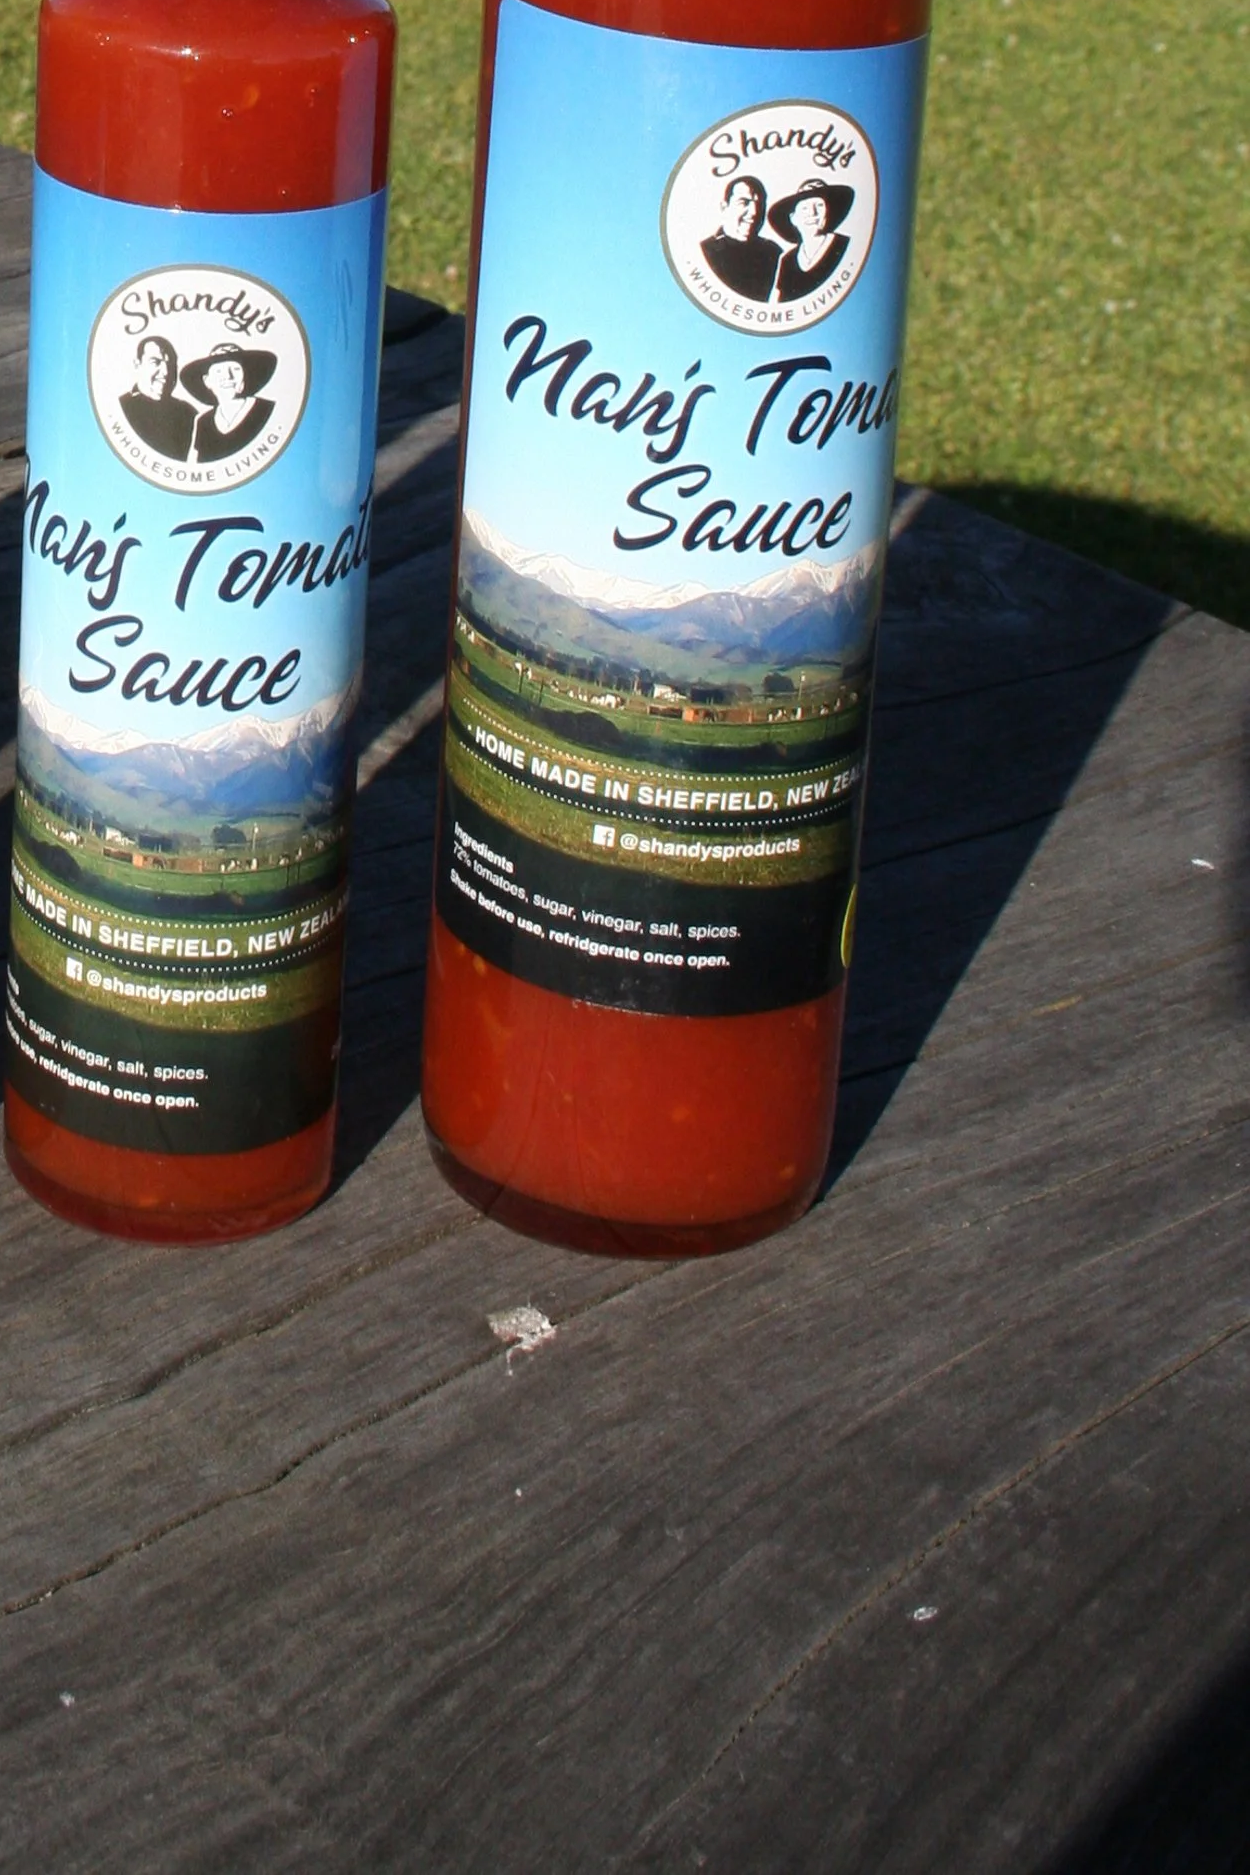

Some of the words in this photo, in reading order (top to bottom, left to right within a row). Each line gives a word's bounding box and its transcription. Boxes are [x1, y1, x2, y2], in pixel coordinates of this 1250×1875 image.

[710, 124, 856, 177] Shandy's
[121, 290, 277, 336] Shandy's
[689, 267, 795, 323] WHOLESOME
[803, 269, 852, 317] LIVING
[503, 315, 716, 463] Nan's
[745, 355, 900, 456] Toma
[111, 421, 216, 483] WHOLESOME
[225, 432, 280, 477] LIVING
[613, 464, 853, 557] Sauce
[169, 473, 373, 611] Tomat
[69, 615, 301, 712] Sauce
[475, 730, 525, 769] HOME
[531, 757, 596, 795] MADE
[604, 782, 629, 801] IN
[637, 787, 779, 812] SHEFFIELD,
[786, 778, 830, 806] NEW
[455, 821, 514, 874] Ingredients
[620, 833, 800, 863] @shandysproducts
[26, 883, 67, 927] MADE
[72, 914, 92, 939] IN
[98, 925, 239, 958] SHEFFIELD,
[248, 925, 295, 954] NEW
[473, 860, 529, 903] tomatoes,
[533, 894, 577, 921] sugar,
[582, 910, 644, 935] vinegar,
[649, 920, 682, 939] salt,
[687, 923, 741, 942] spices.
[478, 891, 515, 923] before
[517, 916, 545, 939] use,
[549, 929, 639, 962] refridgerate
[643, 950, 684, 966] once
[687, 953, 730, 970] open.
[86, 969, 267, 1005] @shandysproducts
[61, 1039, 112, 1071] vinegar,
[117, 1058, 148, 1077] salt,
[153, 1064, 208, 1082] spices.
[113, 1087, 151, 1105] once
[155, 1093, 200, 1110] open.
